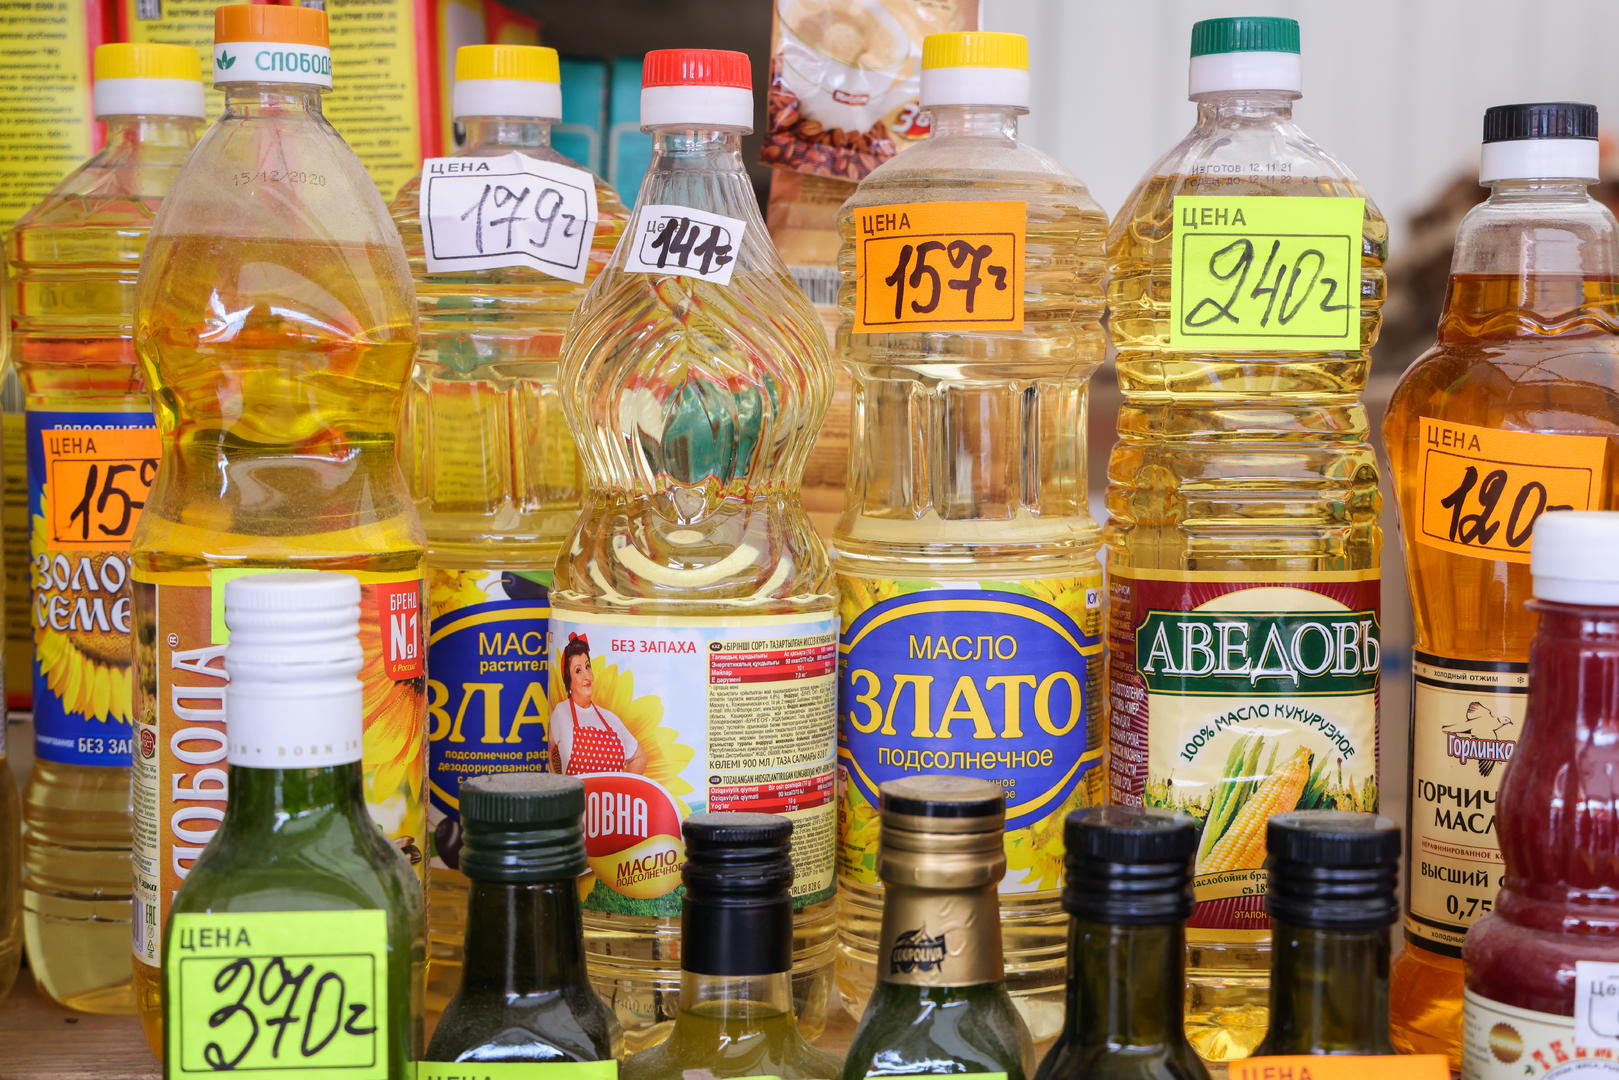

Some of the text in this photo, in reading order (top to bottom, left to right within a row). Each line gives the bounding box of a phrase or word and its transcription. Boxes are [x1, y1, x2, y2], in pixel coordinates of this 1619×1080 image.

[430, 162, 490, 174] ЦЕНА
[863, 212, 911, 236] ЦЕНА
[1182, 207, 1247, 229] ЦЕНА
[50, 438, 97, 456] ЦЕНА
[1427, 425, 1481, 452] ЦЕНА
[35, 553, 132, 594] ЗОЛО
[611, 640, 697, 654] БЕЗ ЗАПАХА
[908, 635, 1018, 660] МАСЛО
[1434, 670, 1467, 680] холодный
[850, 668, 1082, 739] ЗЛАТО
[1180, 725, 1216, 763] 100%
[1214, 703, 1270, 732] МАСЛО
[1274, 703, 1356, 761] КУКУРУЗНОЕ
[78, 737, 104, 753] БЕЗ
[445, 749, 523, 763] подсолнечное
[709, 758, 741, 769] КӨЛЕМІ
[742, 759, 757, 768] 900
[758, 757, 770, 767] МЛ
[776, 755, 792, 765] ТАЗА
[584, 791, 648, 839] ОВНА
[617, 849, 678, 879] МАСЛО
[1421, 861, 1488, 888] ВЫСШИЙ
[1256, 883, 1269, 894] 18
[180, 928, 252, 951] ЦЕНА
